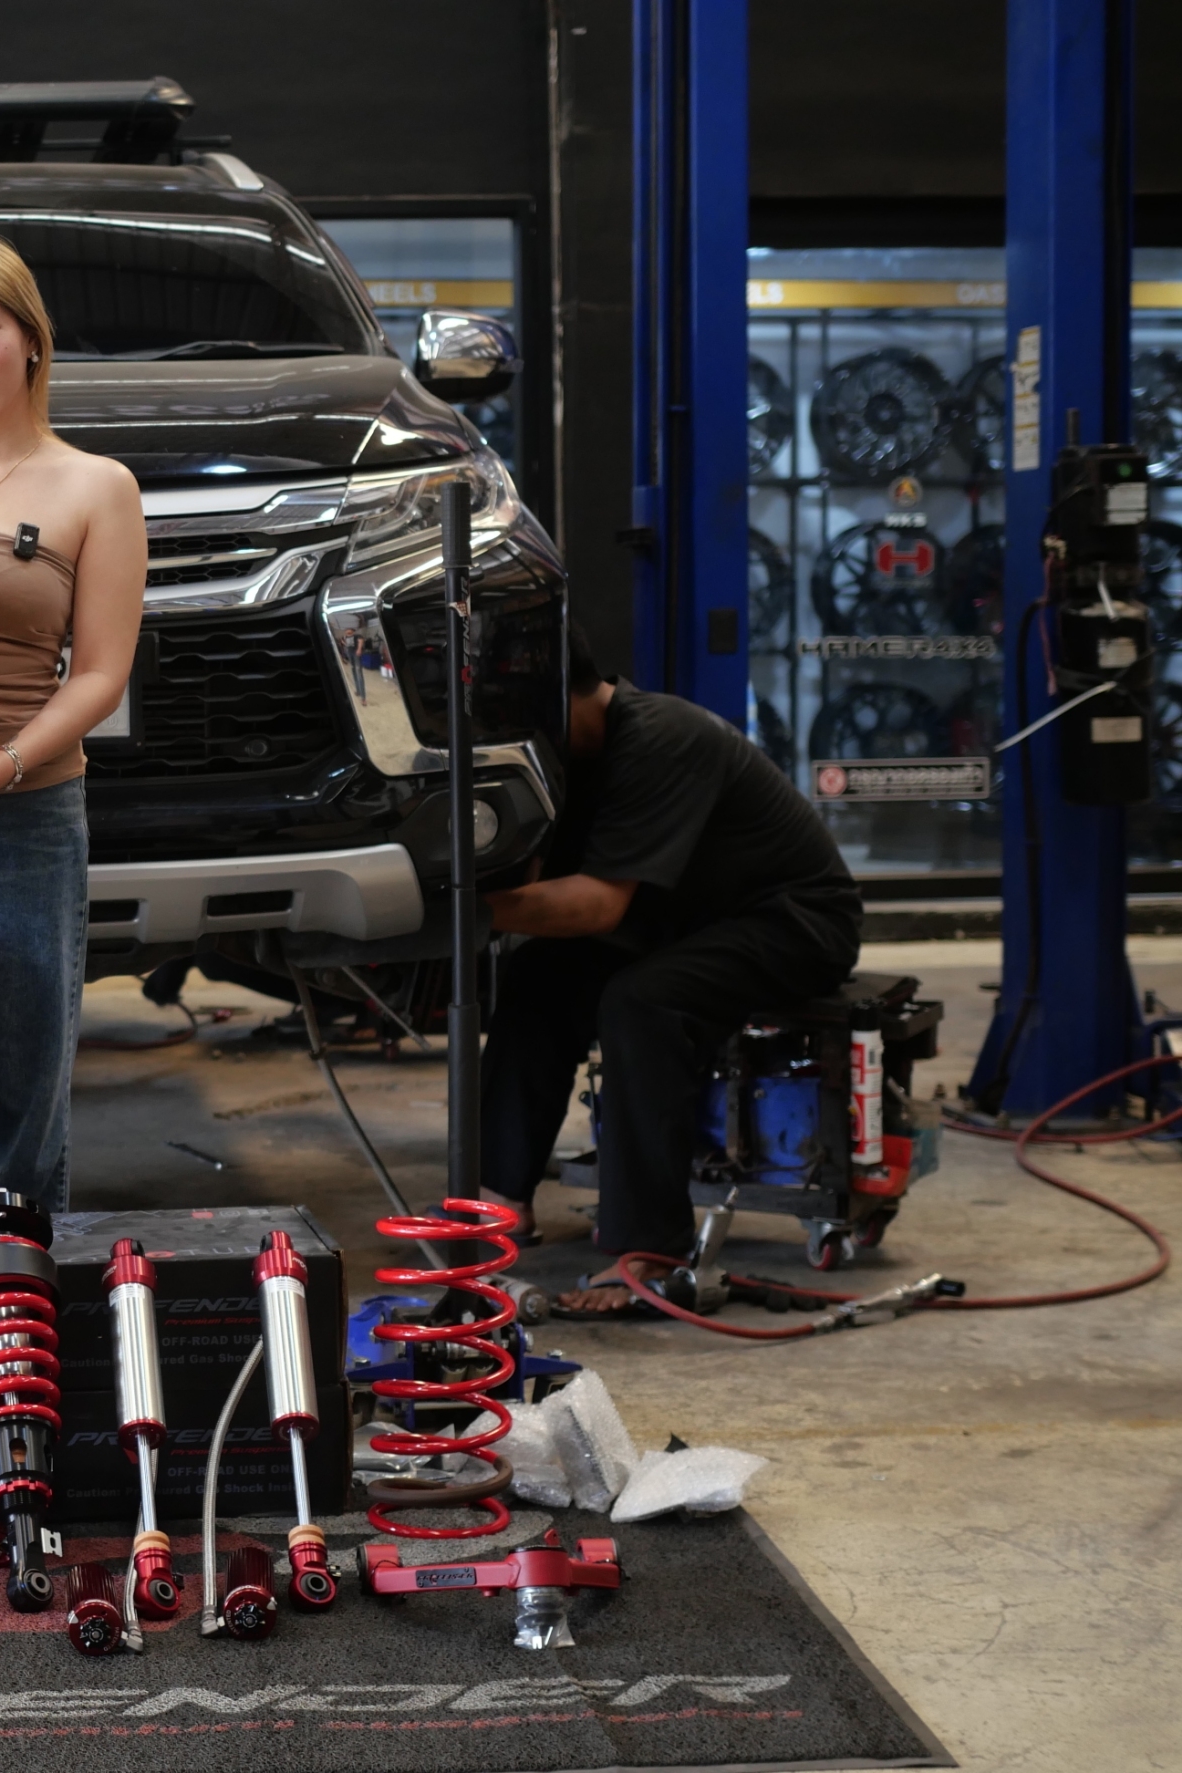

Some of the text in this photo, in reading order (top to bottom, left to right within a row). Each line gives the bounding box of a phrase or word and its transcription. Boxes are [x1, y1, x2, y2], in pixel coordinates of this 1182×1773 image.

[956, 283, 1006, 305] OAS
[162, 1335, 229, 1347] OFF-ROAD
[218, 1353, 250, 1363] Shoc
[167, 1464, 293, 1477] OFF-RAD USE ON
